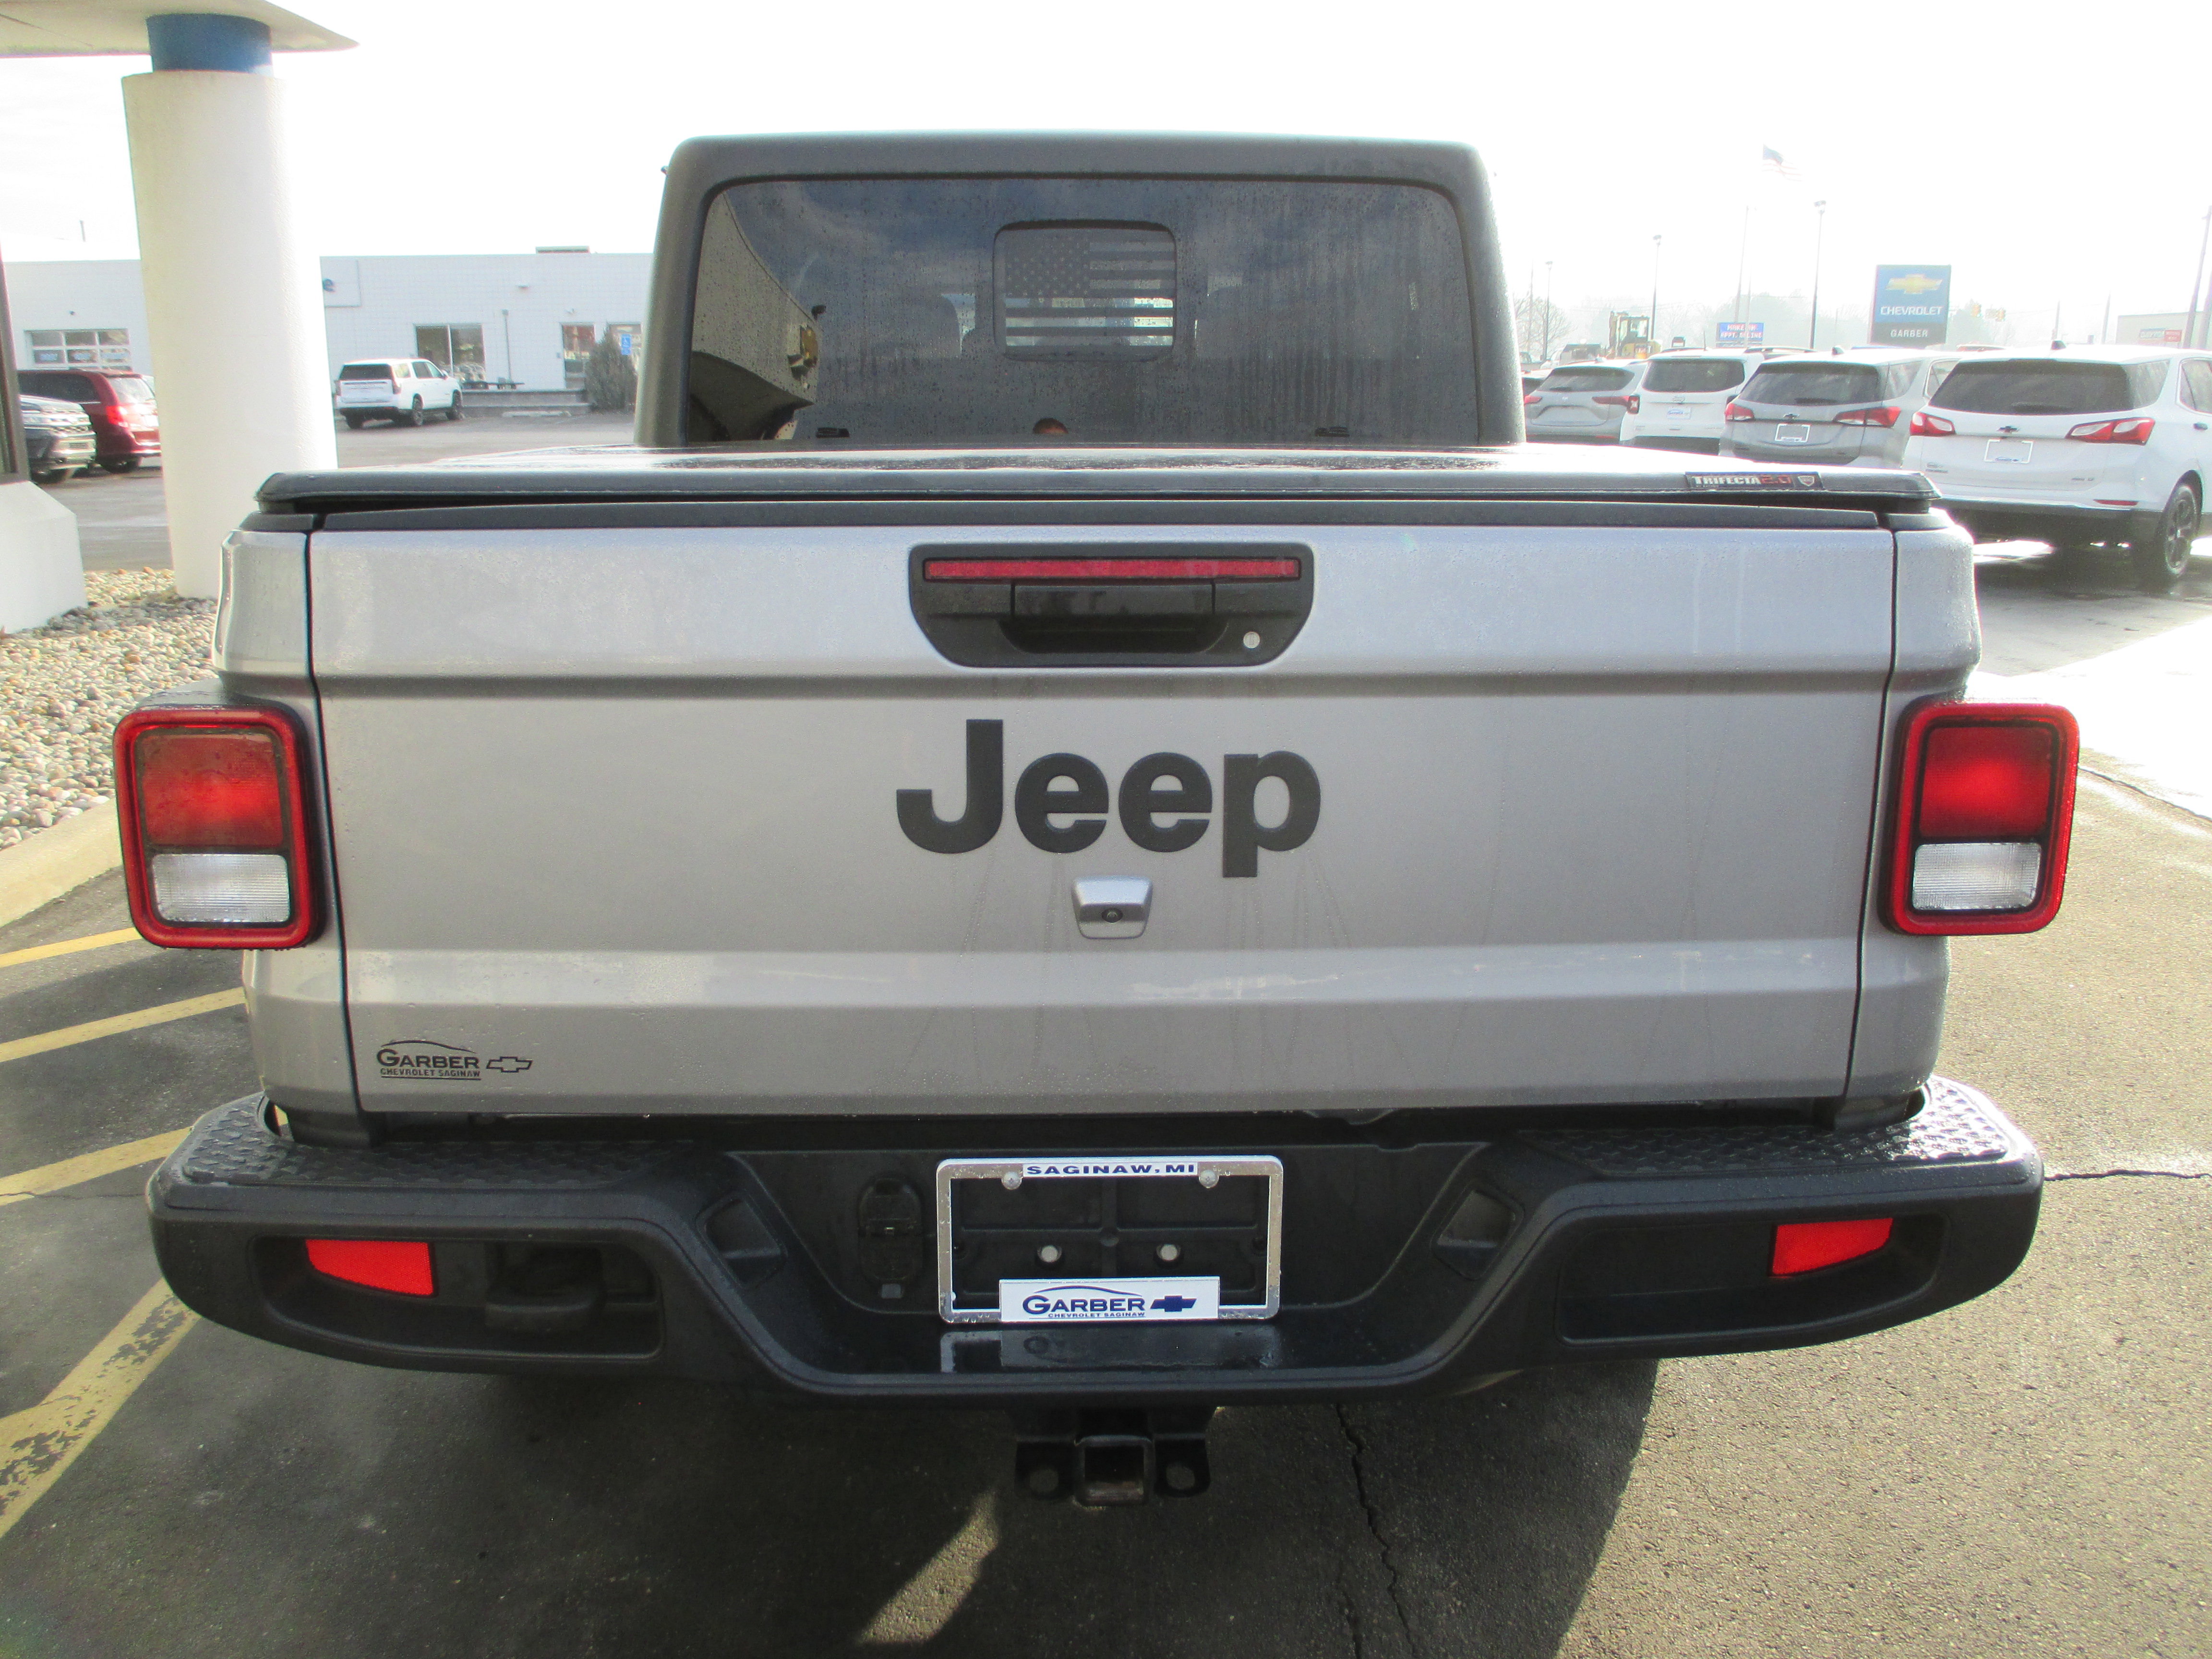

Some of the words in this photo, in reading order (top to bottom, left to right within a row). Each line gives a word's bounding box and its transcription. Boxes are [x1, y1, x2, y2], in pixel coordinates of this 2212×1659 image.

[1880, 306, 1942, 315] CHEVROLET
[1890, 329, 1928, 337] GARBER
[1692, 476, 1761, 485] TRIFECTA
[896, 719, 1321, 878] Jeep
[377, 1048, 480, 1069] GARBER
[380, 1068, 434, 1076] CHEVROLET
[1022, 1295, 1145, 1314] GARBER
